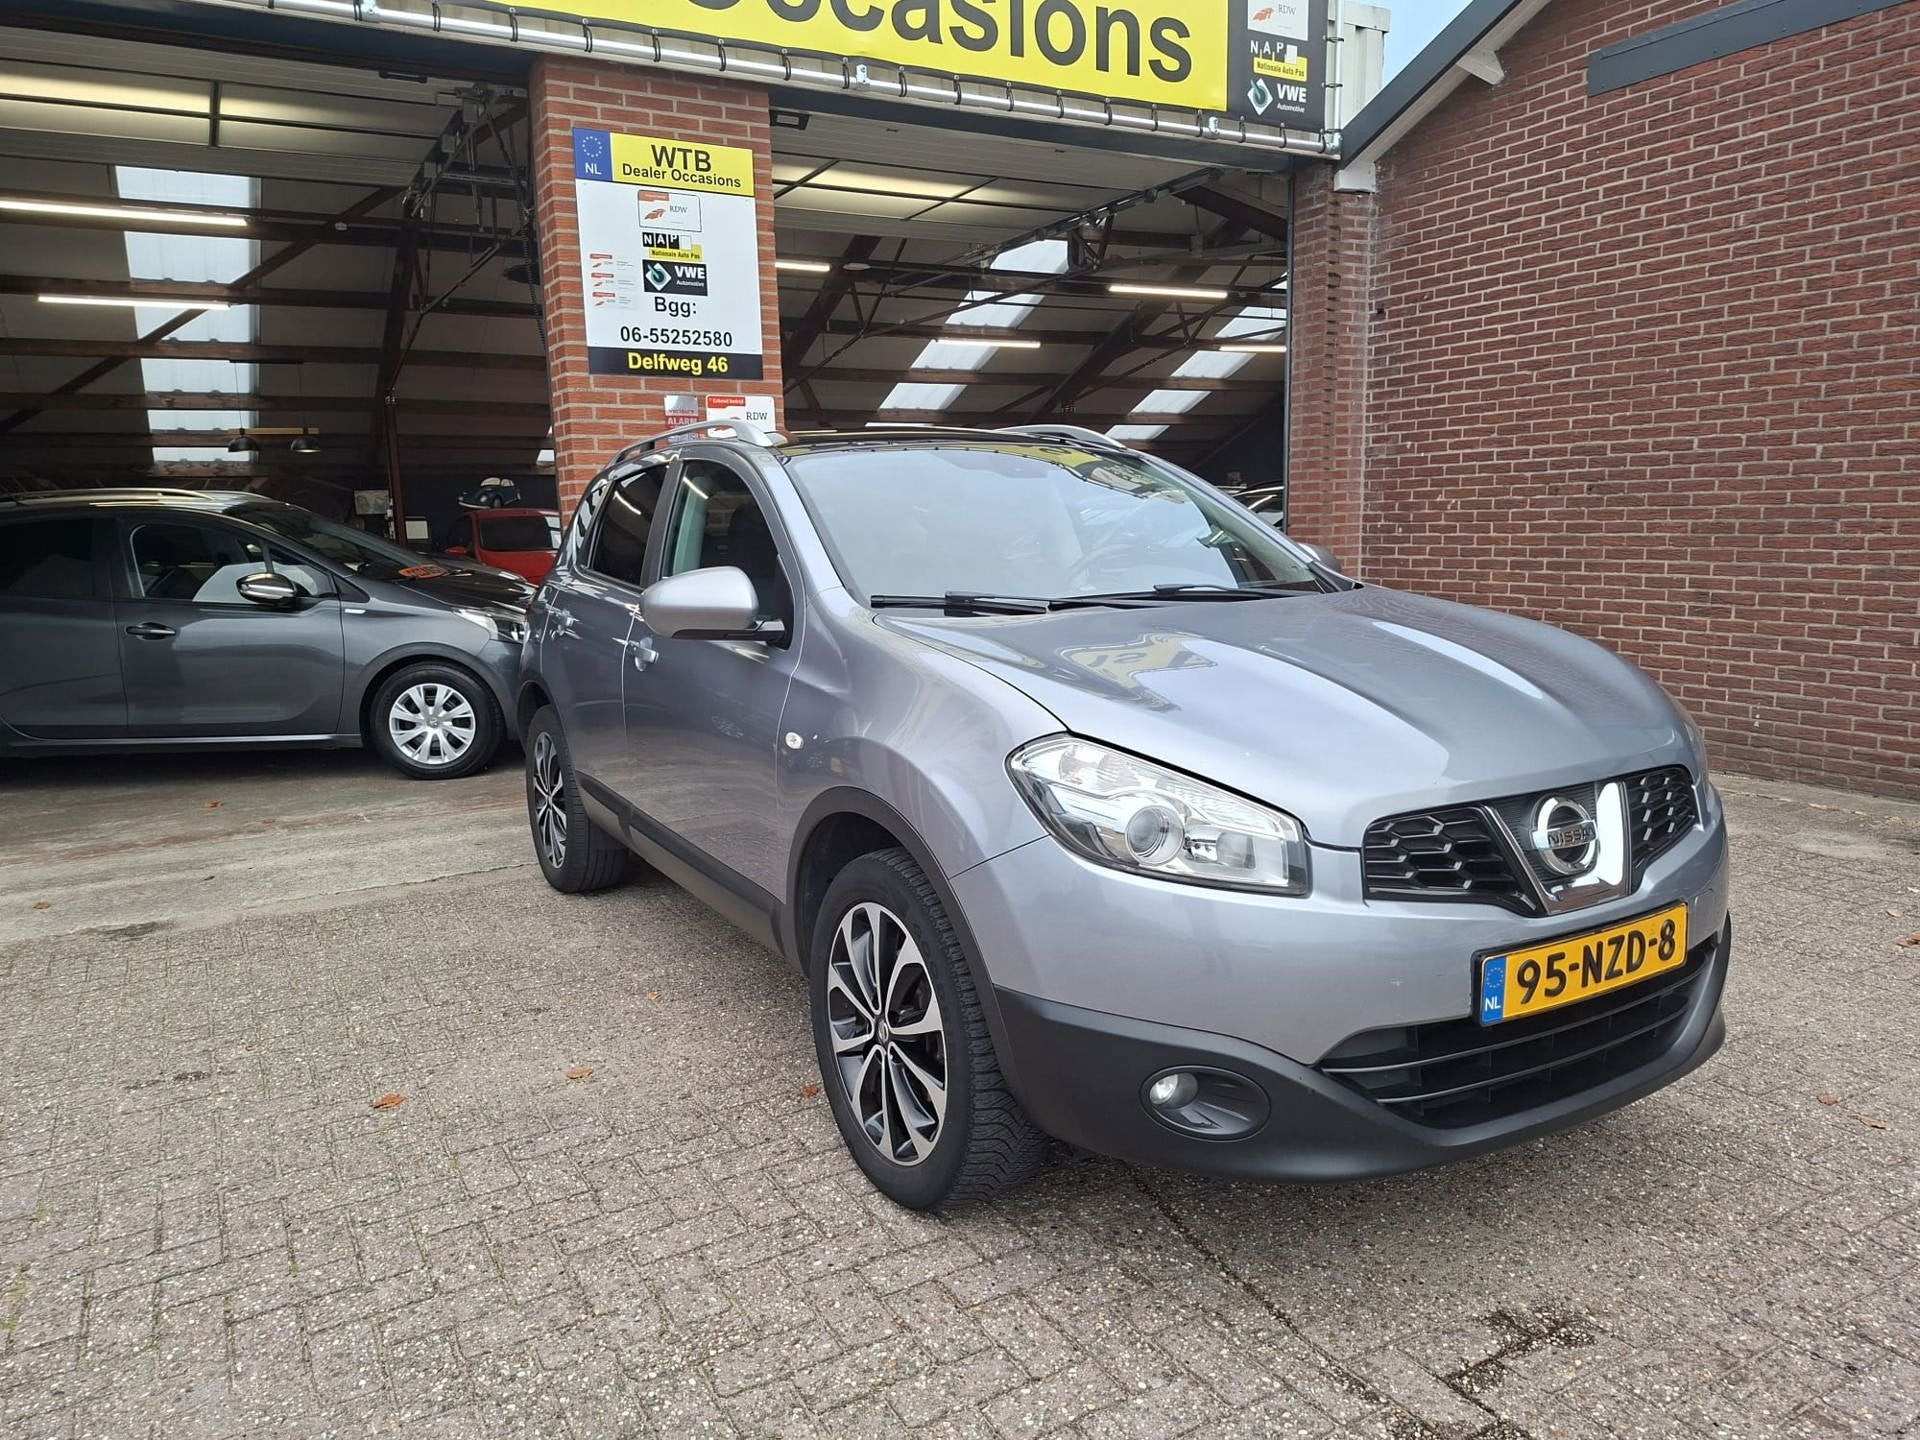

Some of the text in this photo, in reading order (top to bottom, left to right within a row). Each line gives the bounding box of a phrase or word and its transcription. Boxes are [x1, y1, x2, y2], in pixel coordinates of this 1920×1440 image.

[1279, 4, 1297, 15] RDW
[688, 0, 1192, 83] asions
[1257, 61, 1305, 77] Nationale Auto Pas
[1277, 83, 1307, 102] VWE
[1277, 103, 1305, 113] Automotive
[651, 144, 712, 172] WTB
[585, 162, 602, 175] NL
[622, 163, 741, 188] Dealer Occasions
[669, 205, 687, 213] RDW
[674, 265, 706, 279] VWE
[676, 280, 704, 288] Automotive
[655, 296, 697, 317] Bgg:
[620, 326, 733, 347] 06-55252580
[628, 351, 728, 375] Delfweg 46
[667, 417, 698, 425] ALARM
[746, 411, 768, 420] RDW
[1516, 918, 1676, 1004] 95-NZD-8
[1484, 995, 1501, 1010] NL
